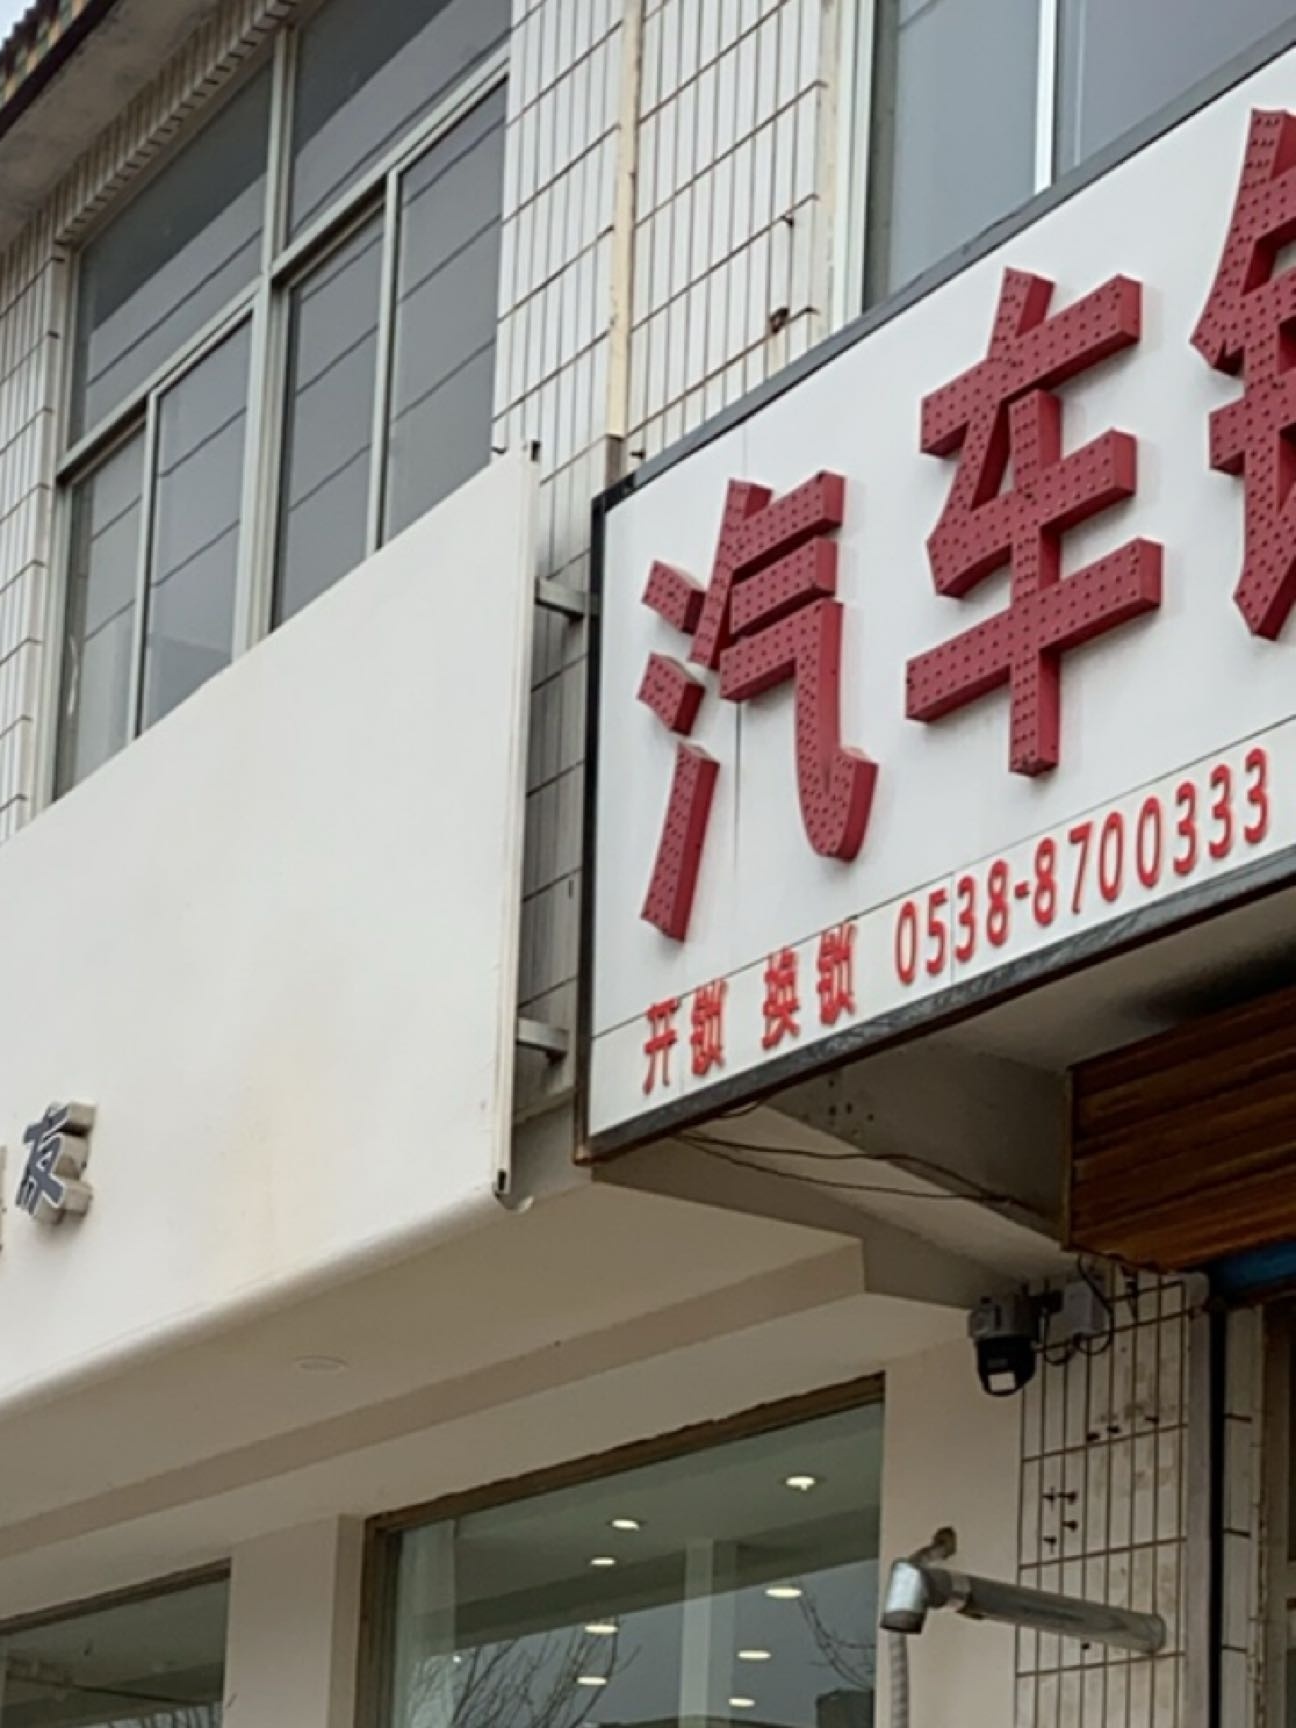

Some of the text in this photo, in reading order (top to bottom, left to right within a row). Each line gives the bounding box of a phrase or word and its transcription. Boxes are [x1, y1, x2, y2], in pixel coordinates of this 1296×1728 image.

[643, 747, 1270, 1096] 开锁 换锁 0538-8700333
